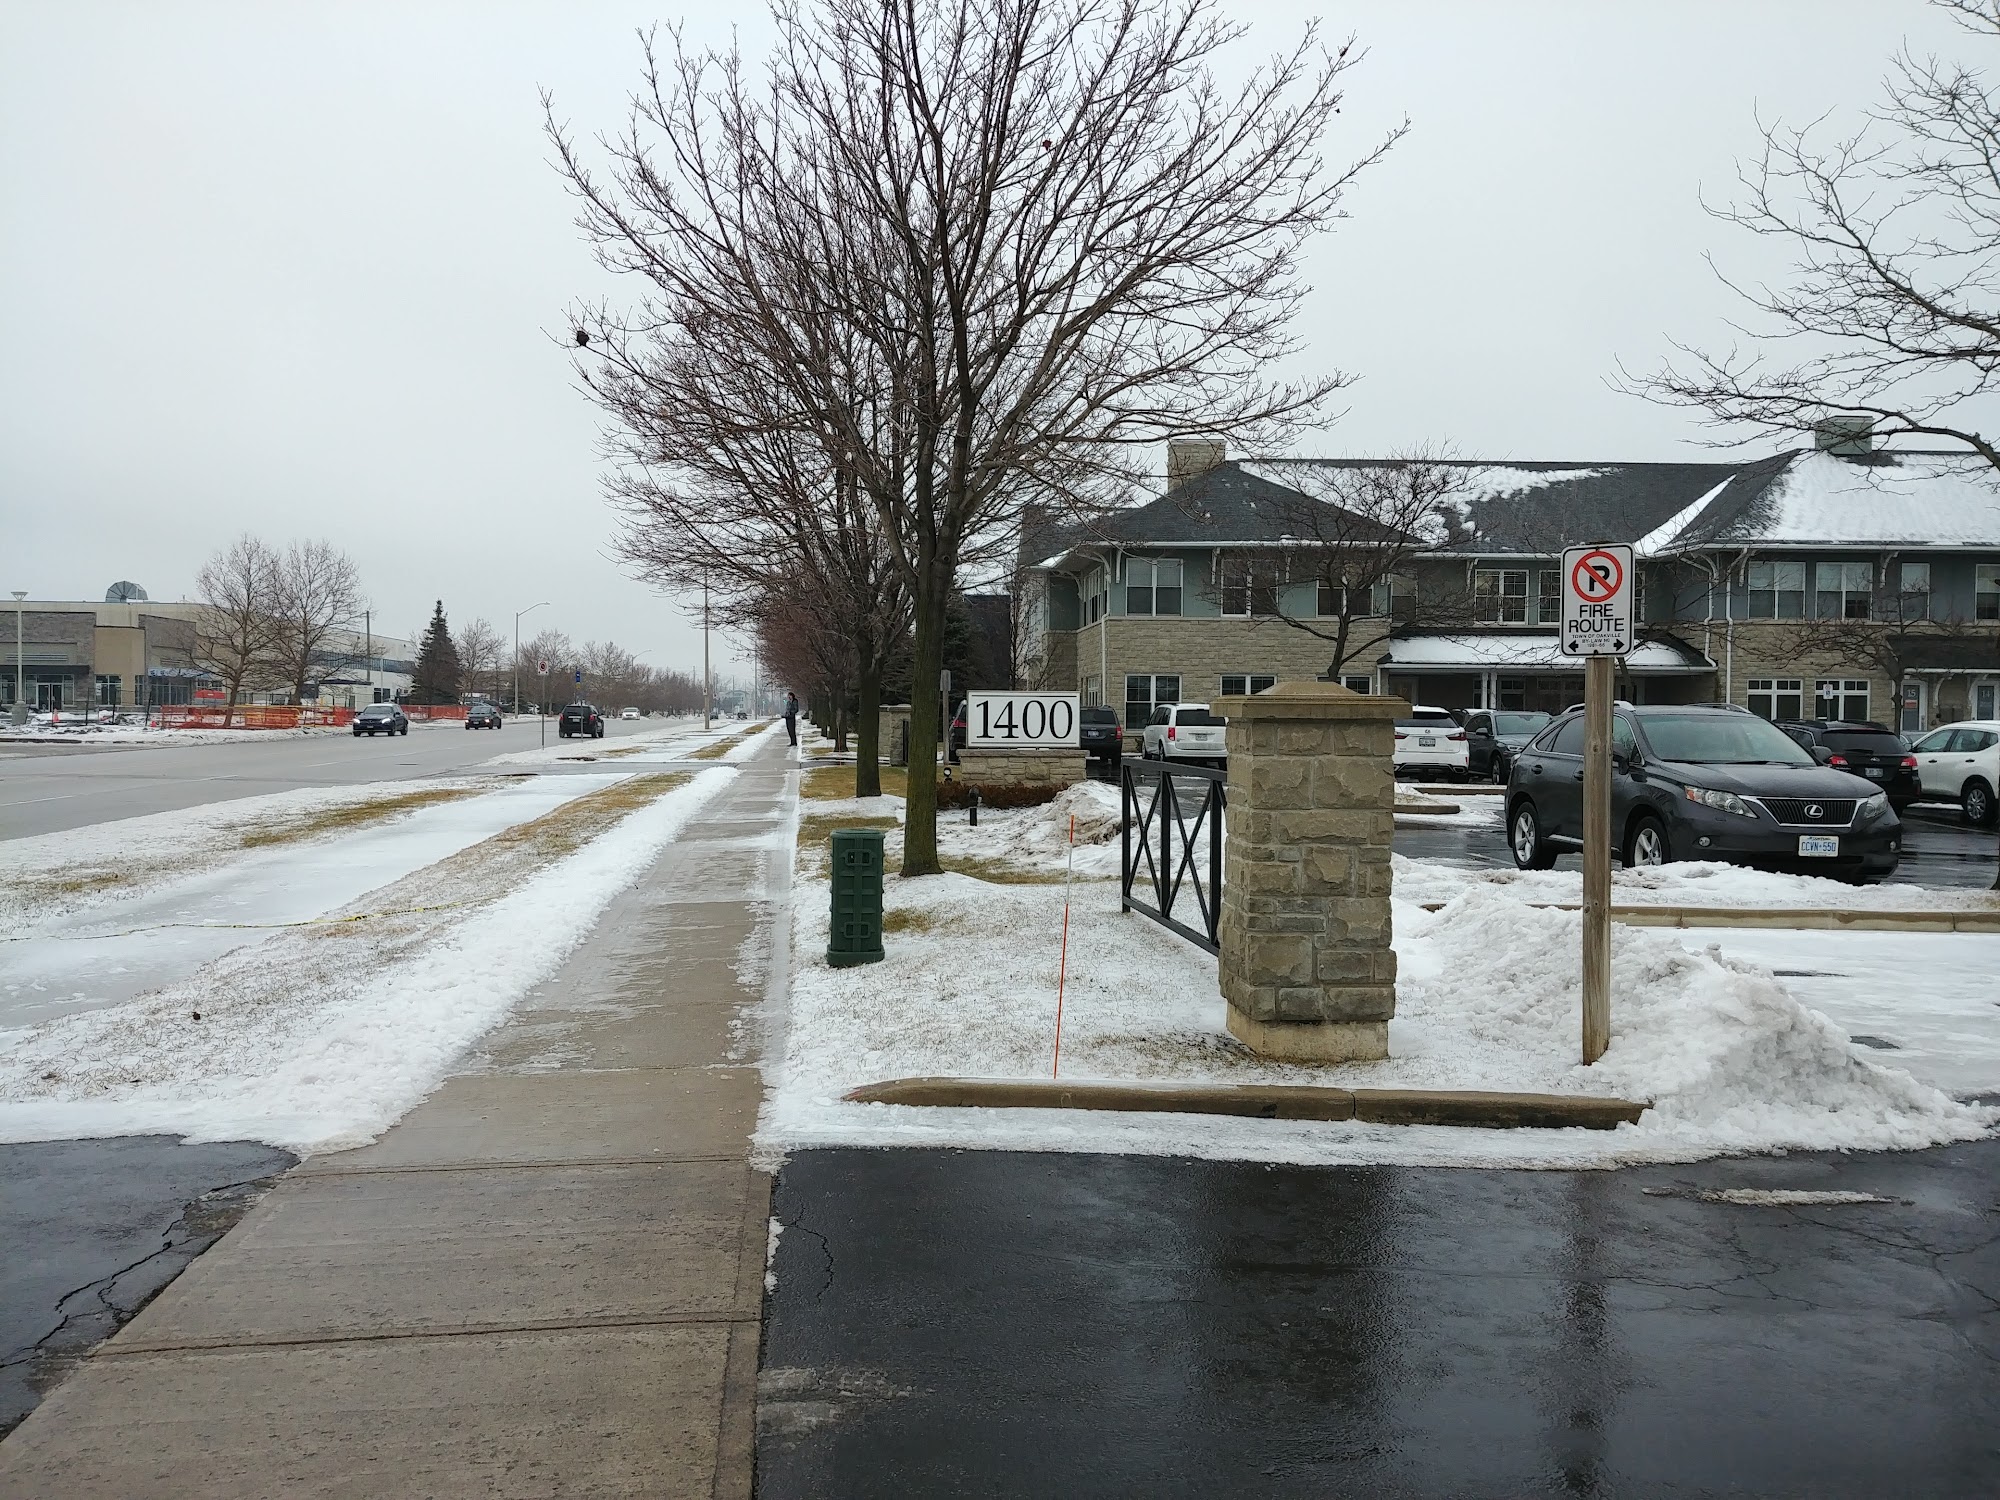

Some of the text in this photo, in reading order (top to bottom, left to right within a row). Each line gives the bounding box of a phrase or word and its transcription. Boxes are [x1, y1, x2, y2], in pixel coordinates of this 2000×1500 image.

[1579, 603, 1614, 618] FIRE
[1568, 617, 1625, 633] ROUTE
[1907, 689, 1916, 698] 15
[976, 699, 1073, 739] 1400
